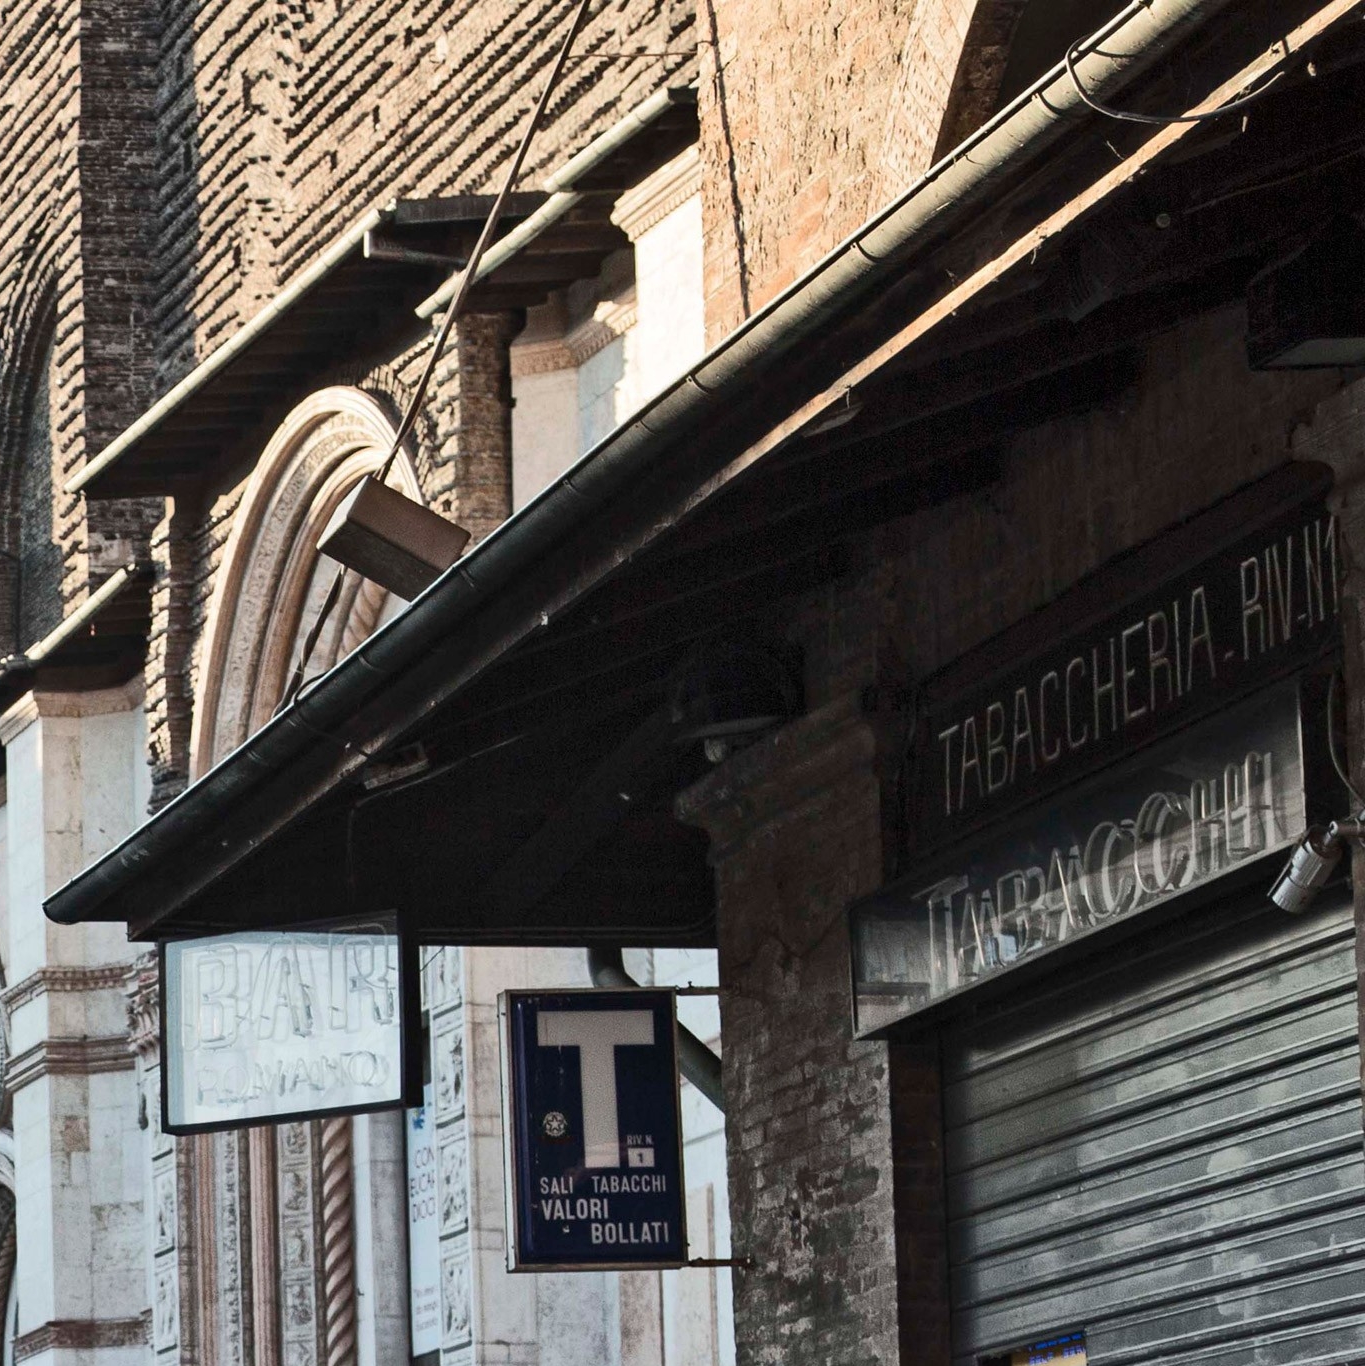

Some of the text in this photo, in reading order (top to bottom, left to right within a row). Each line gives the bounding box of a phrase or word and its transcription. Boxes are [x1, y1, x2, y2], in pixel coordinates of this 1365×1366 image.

[182, 922, 398, 1051] BAR
[537, 1010, 655, 1168] T
[540, 1174, 667, 1195] SALI TABACCHI
[541, 1198, 609, 1221] VALORI
[590, 1221, 670, 1245] BOLLATI
